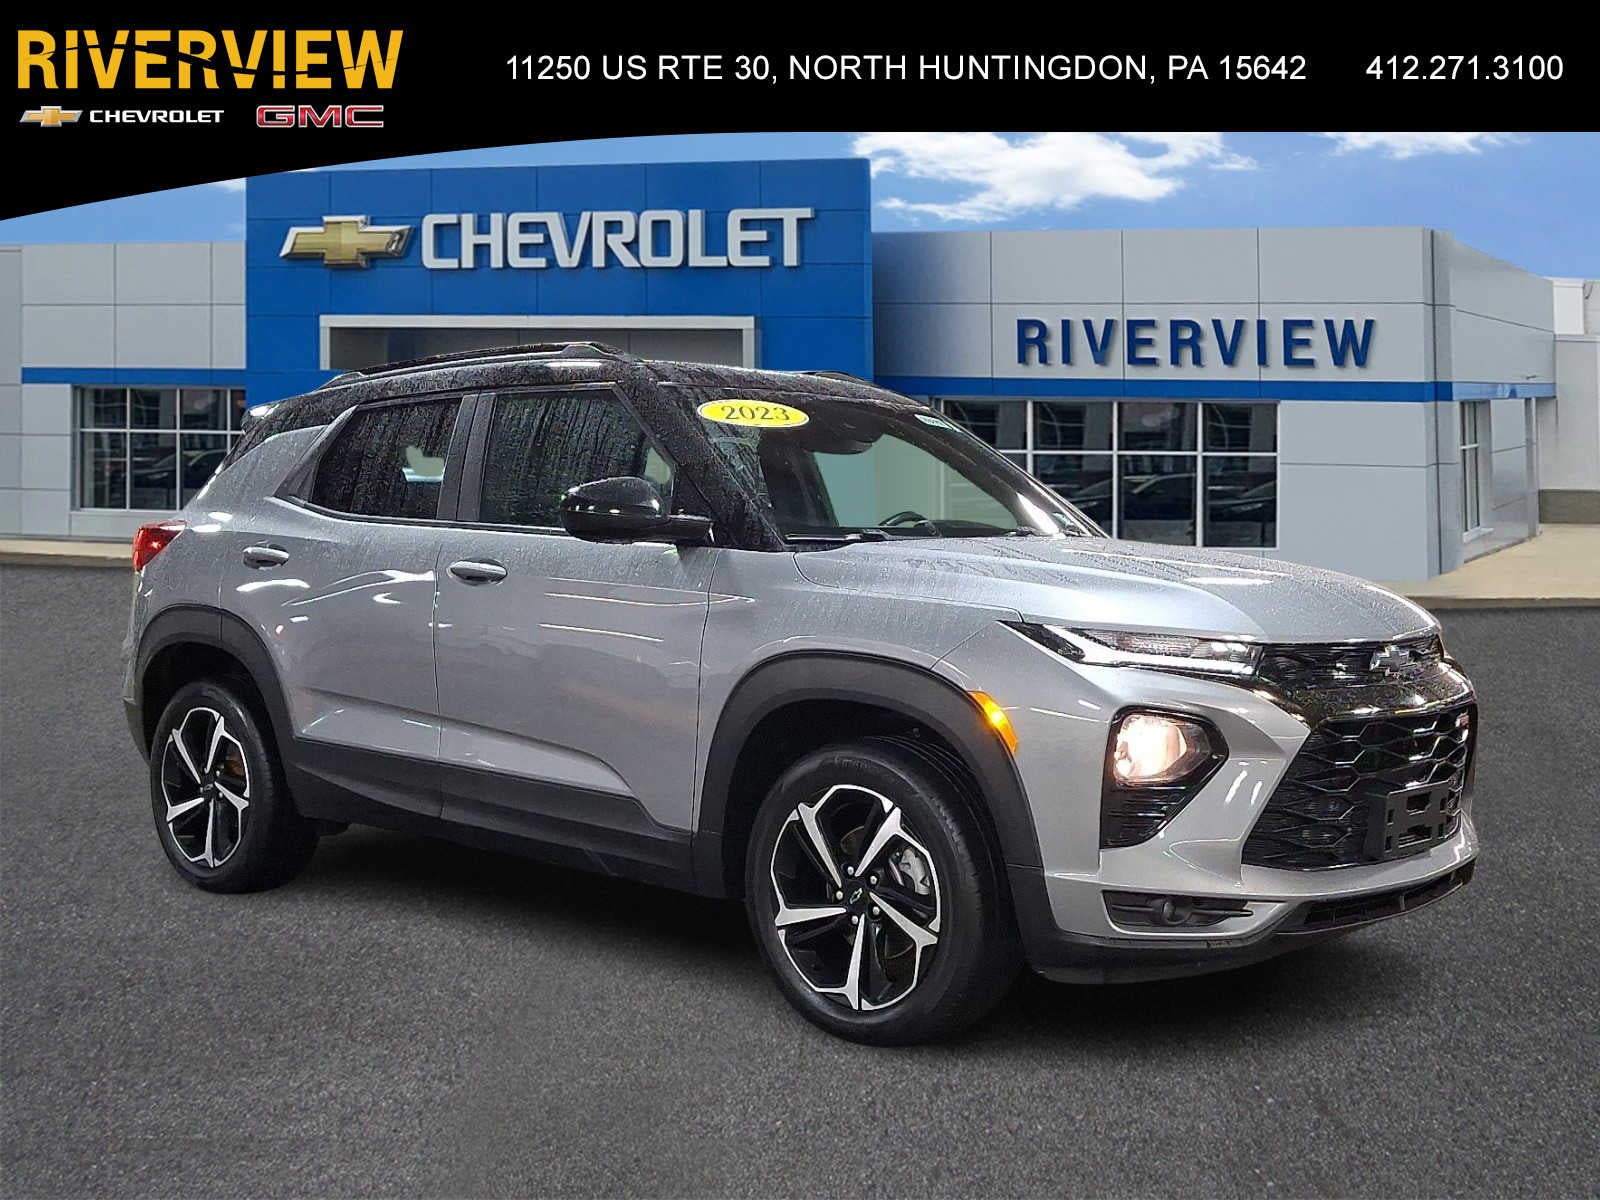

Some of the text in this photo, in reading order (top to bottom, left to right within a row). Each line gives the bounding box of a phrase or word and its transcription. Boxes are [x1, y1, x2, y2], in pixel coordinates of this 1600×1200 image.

[421, 207, 815, 270] CHEVROLET
[1016, 318, 1376, 369] RIVERVIEW
[720, 405, 790, 421] 2023
